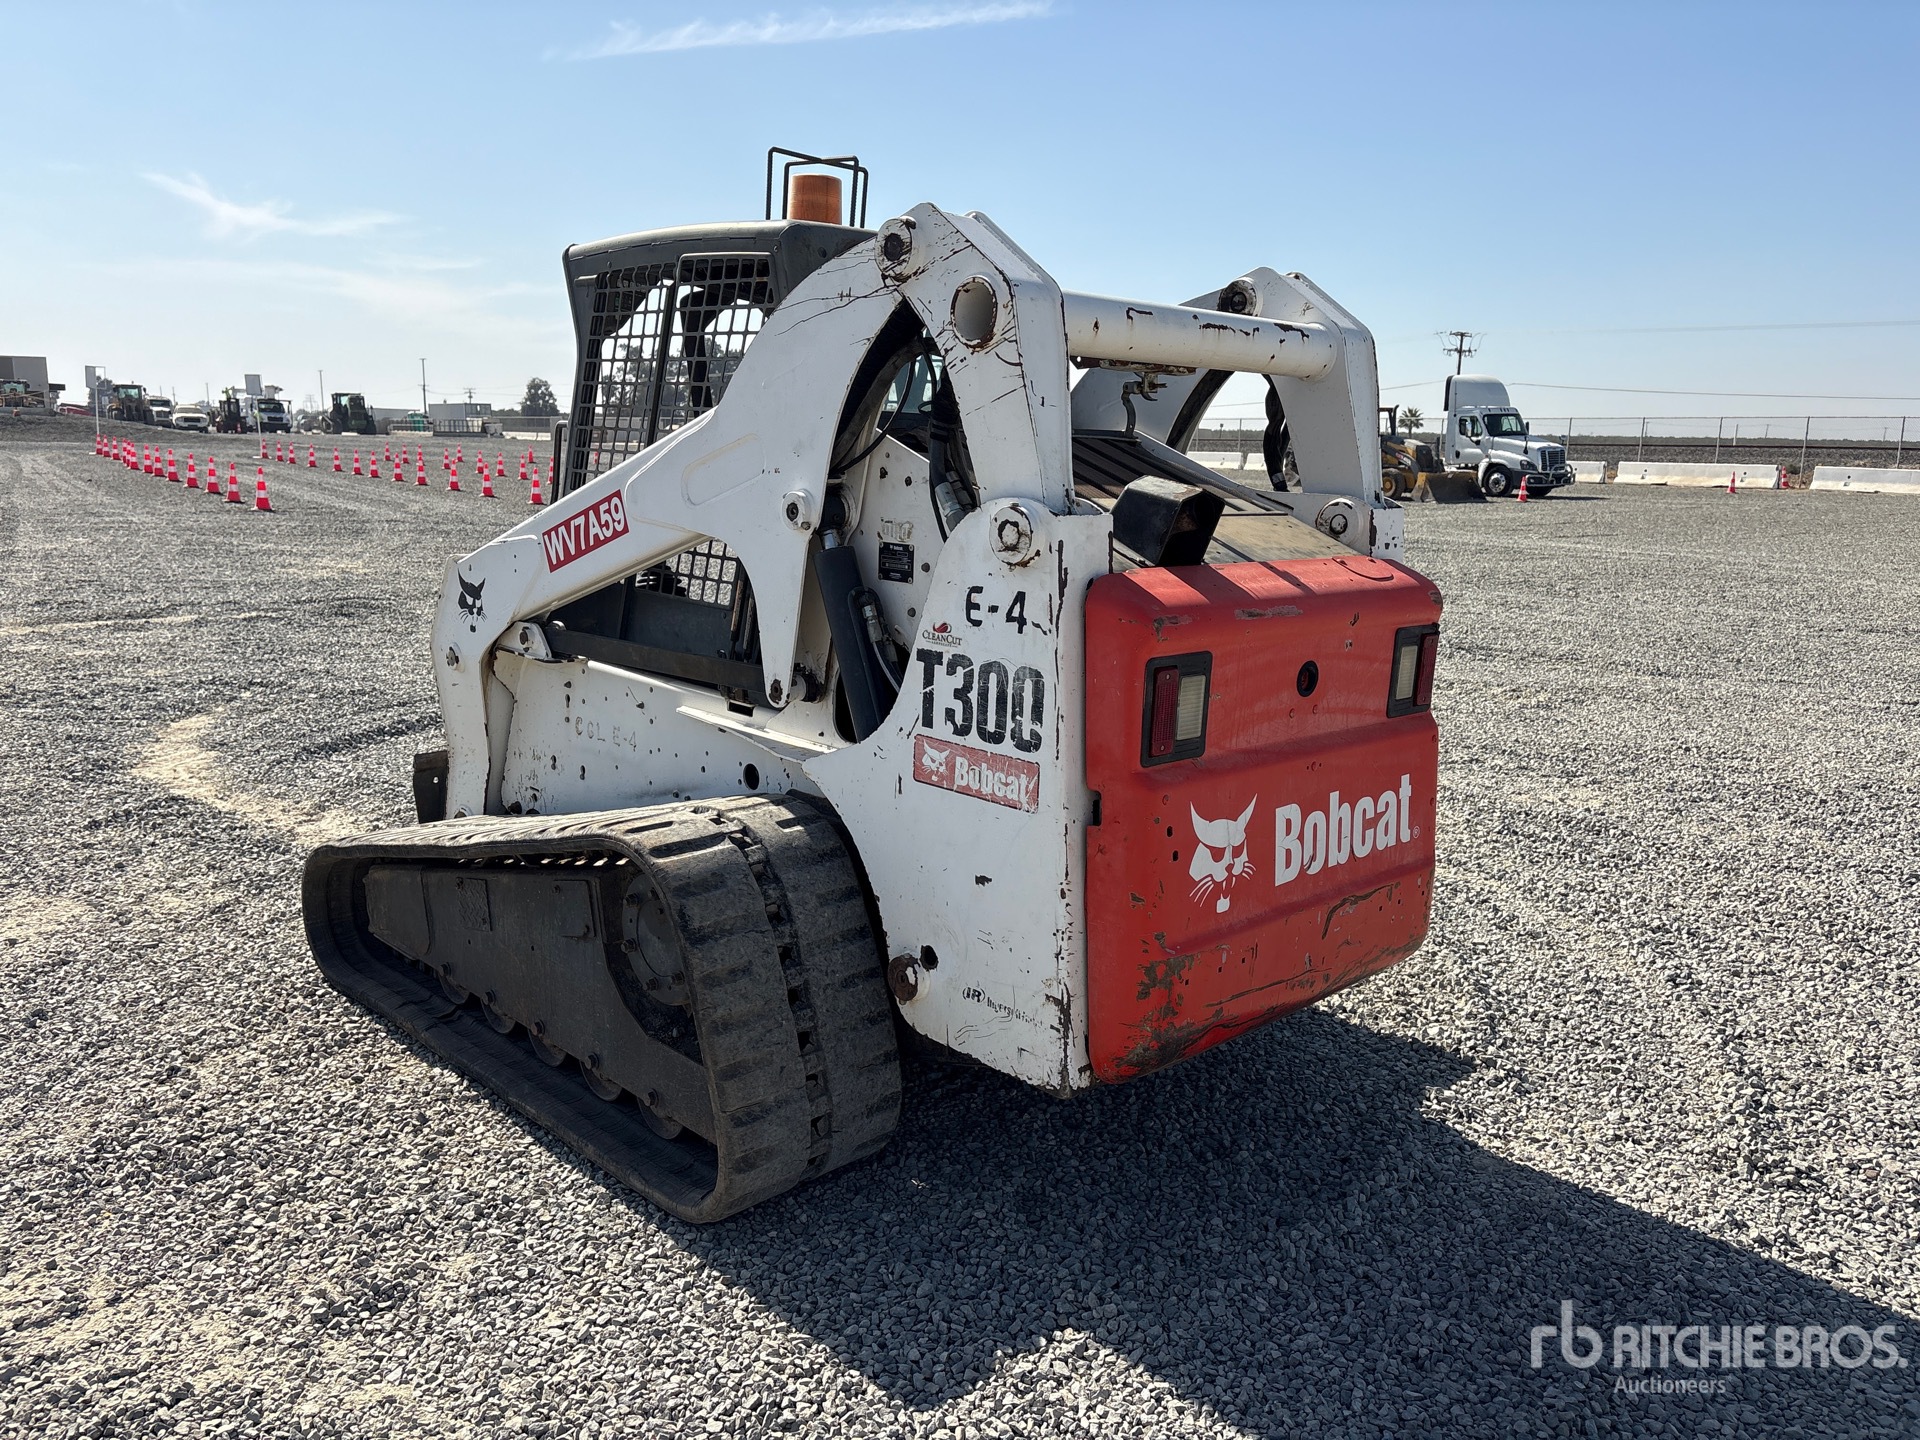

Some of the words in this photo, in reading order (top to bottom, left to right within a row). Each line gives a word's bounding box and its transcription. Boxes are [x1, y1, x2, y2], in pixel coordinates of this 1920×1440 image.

[543, 496, 625, 565] WV7A59
[965, 585, 1028, 635] E-4
[916, 647, 1045, 754] T300
[955, 756, 1029, 801] Bobcat
[1275, 773, 1412, 887] Bobcat
